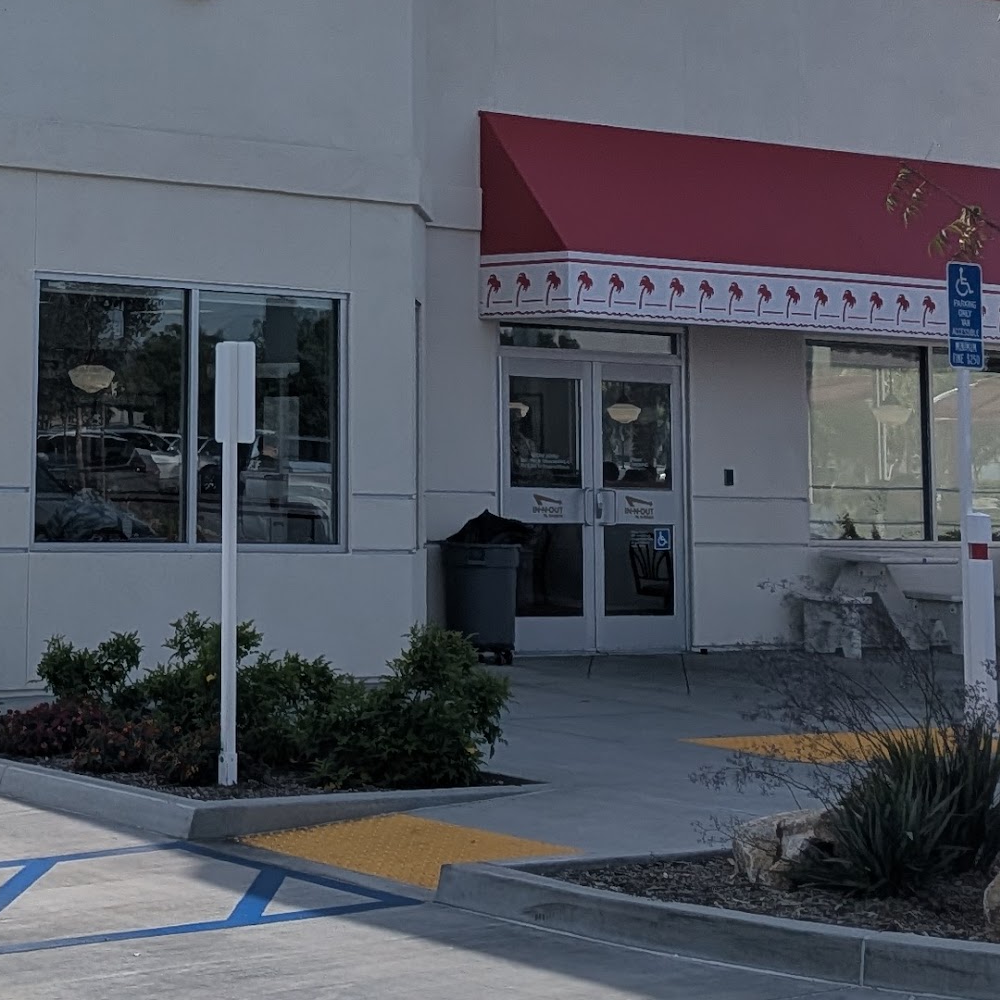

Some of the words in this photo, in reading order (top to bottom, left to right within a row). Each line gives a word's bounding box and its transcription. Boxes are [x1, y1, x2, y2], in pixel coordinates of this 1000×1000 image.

[953, 299, 977, 310] PARKING
[957, 309, 973, 318] ONLY
[951, 327, 980, 338] ACCESSIBLE
